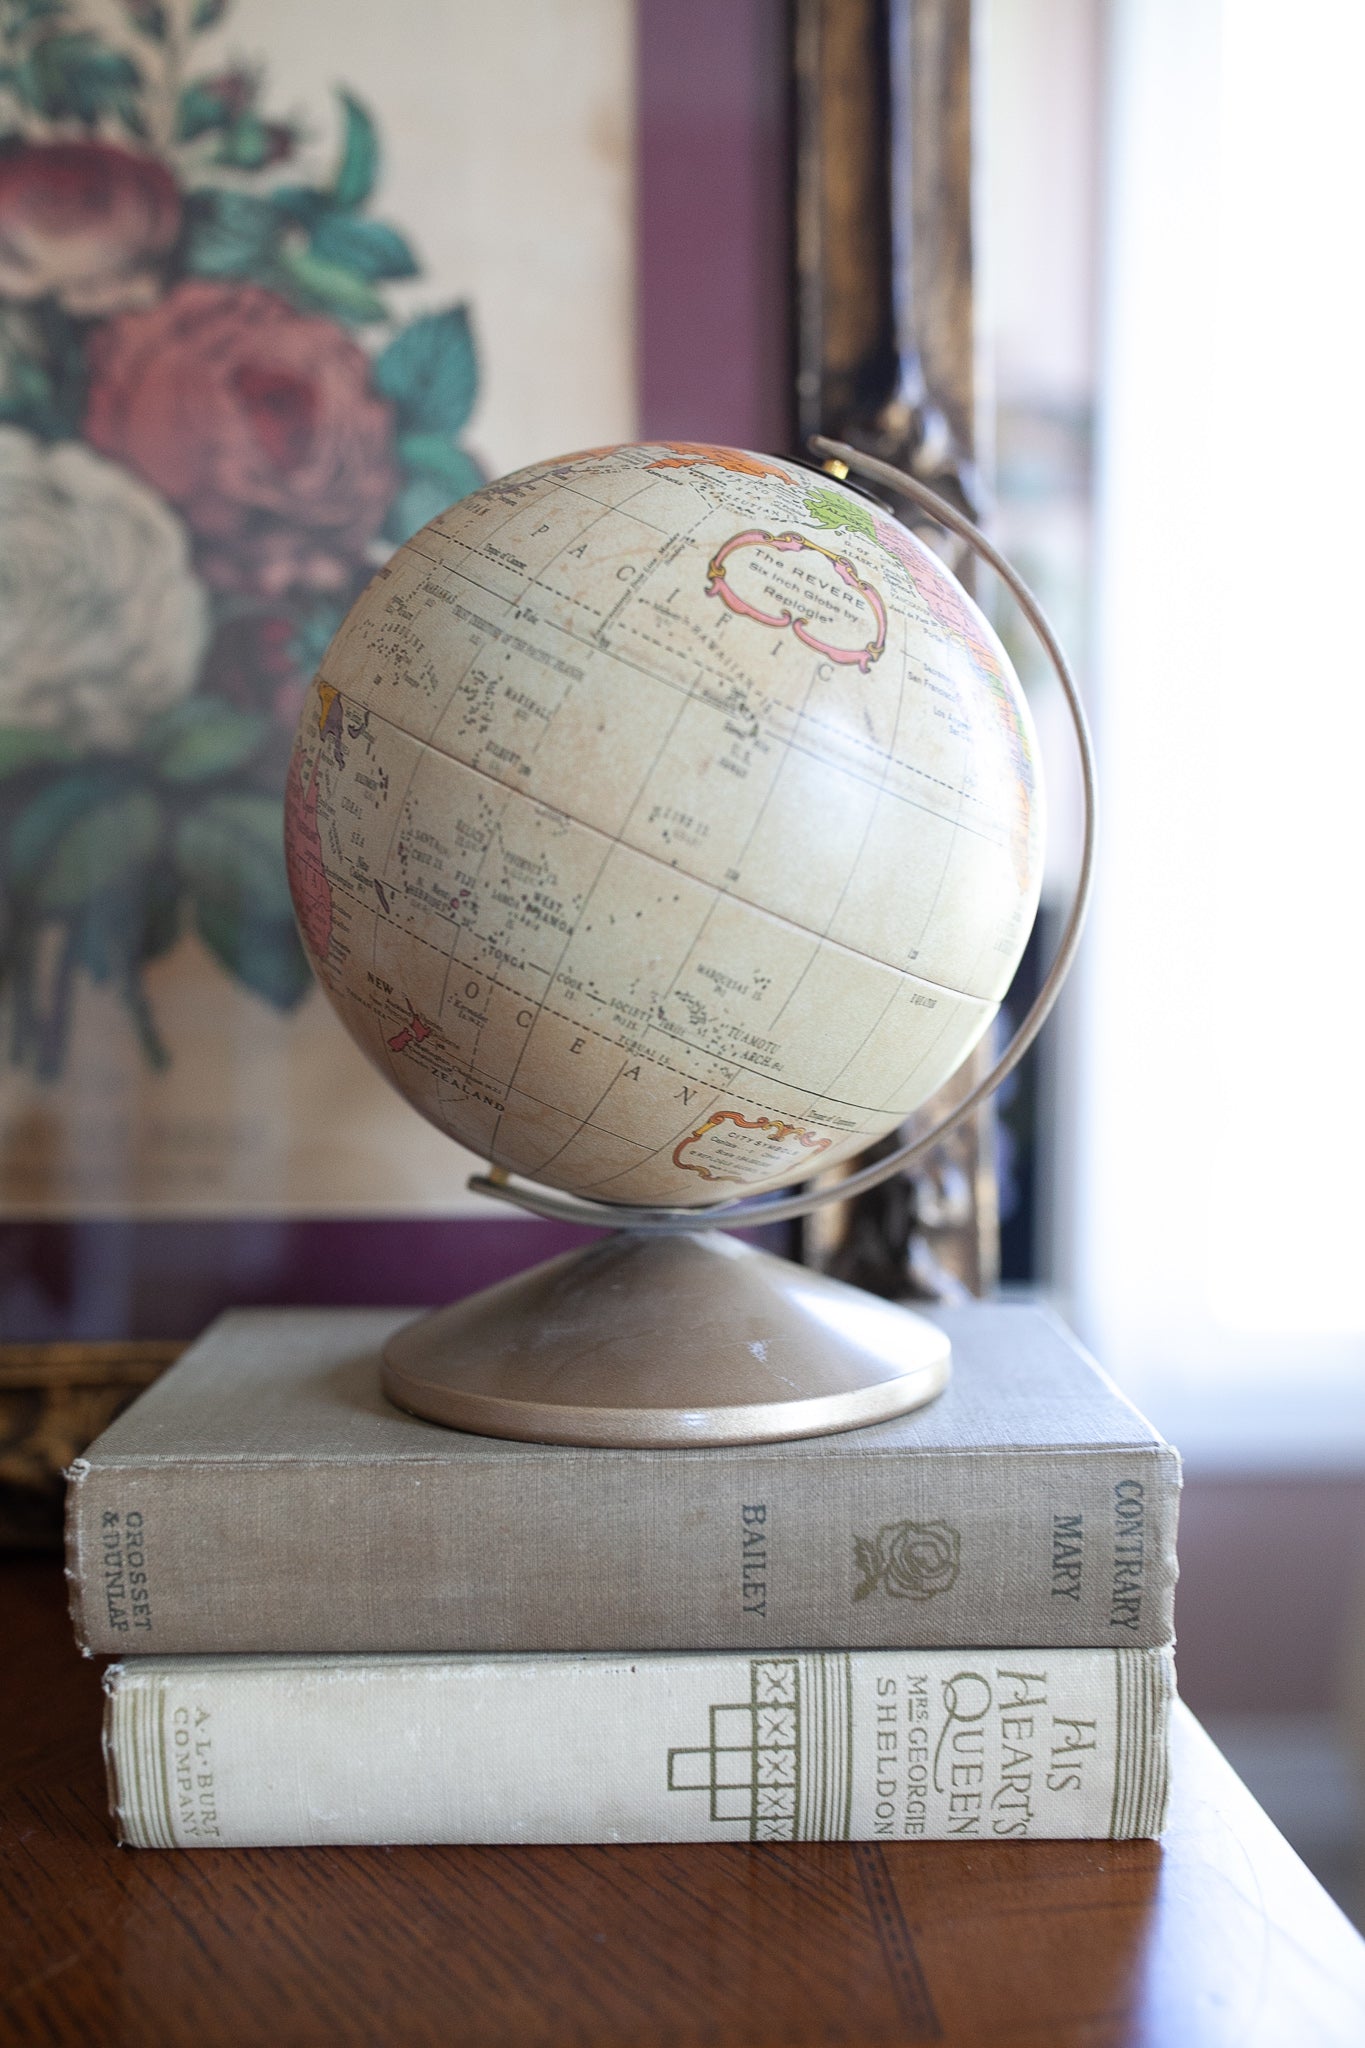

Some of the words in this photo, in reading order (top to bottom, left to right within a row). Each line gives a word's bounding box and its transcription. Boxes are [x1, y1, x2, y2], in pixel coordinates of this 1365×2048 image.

[749, 562, 768, 577] Six
[804, 590, 840, 613] Globe
[844, 609, 859, 623] by
[755, 548, 784, 568] The
[792, 567, 866, 611] REVERE
[840, 549, 879, 572] ALASKA
[366, 971, 394, 995] NEW
[431, 1066, 505, 1112] ZEALAND
[124, 1511, 152, 1633] GROSSET
[741, 1503, 768, 1618] BAILEY
[1050, 1513, 1084, 1603] MARY
[1110, 1479, 1144, 1632] CONTRARY
[173, 1706, 199, 1838] COMPANY
[873, 1676, 898, 1835] SHELDON
[904, 1727, 929, 1836] GEORGIE
[933, 1671, 993, 1835] QUEEN
[991, 1668, 1048, 1836] HEART'S
[1046, 1715, 1098, 1792] HIS
[198, 1773, 220, 1839] BURT
